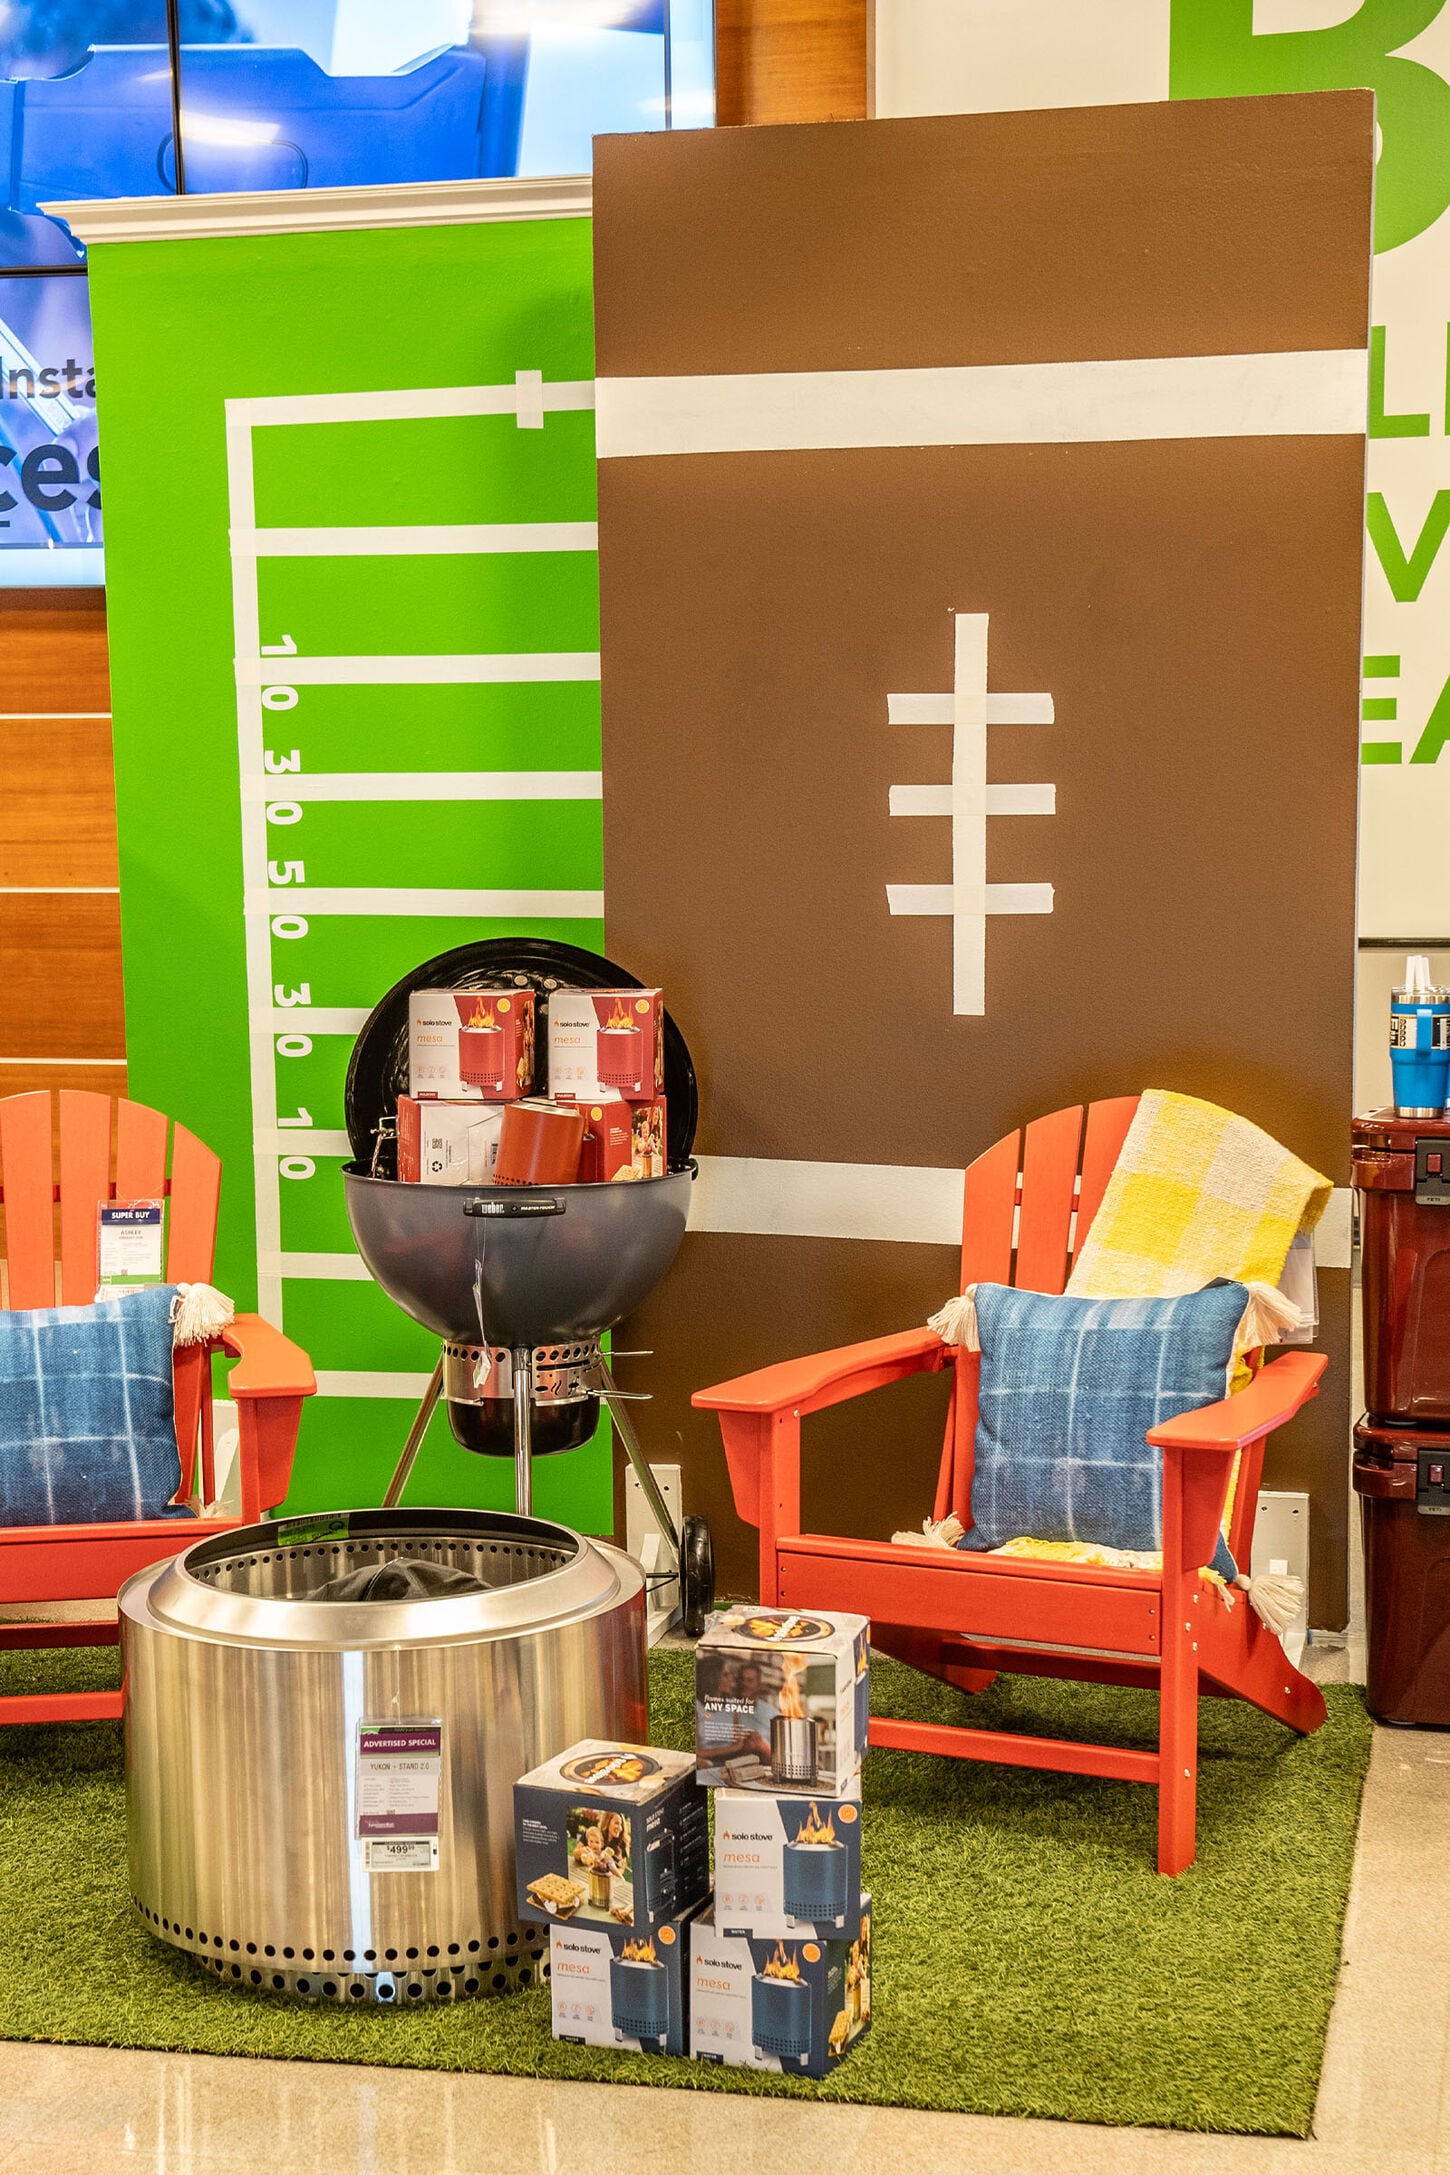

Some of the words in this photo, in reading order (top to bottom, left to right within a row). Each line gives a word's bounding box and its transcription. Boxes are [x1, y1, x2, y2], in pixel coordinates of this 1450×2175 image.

[554, 1036, 581, 1044] mesa
[112, 1211, 133, 1219] SUPER
[135, 1211, 150, 1219] BUY
[745, 1697, 754, 1705] for
[704, 1702, 723, 1712] ANY
[725, 1703, 755, 1714] SPACE
[363, 1740, 407, 1748] ADVERTISED
[408, 1738, 436, 1747] SPECIAL
[370, 1762, 391, 1770] YUKON
[399, 1762, 418, 1770] STAND
[732, 1832, 749, 1841] solo
[750, 1833, 773, 1841] stove
[723, 1852, 761, 1863] mesa
[563, 1943, 579, 1951] solo
[580, 1945, 601, 1955] stove
[557, 1961, 590, 1974] mesa
[704, 1958, 720, 1967] solo
[721, 1960, 742, 1971] stove
[697, 1977, 731, 1991] mesa
